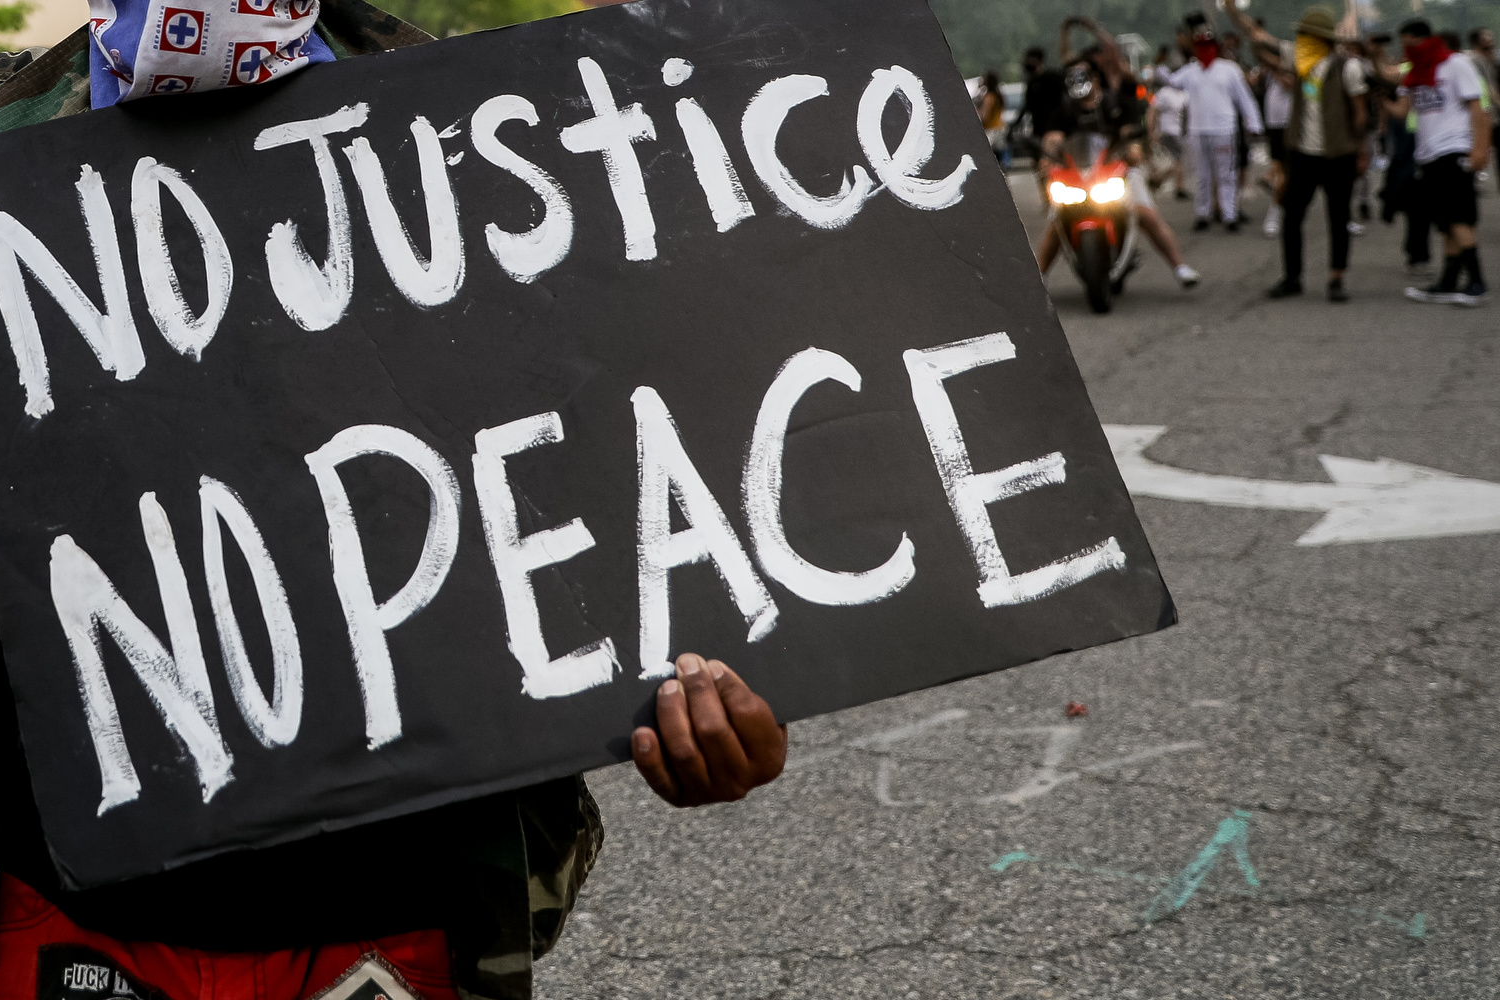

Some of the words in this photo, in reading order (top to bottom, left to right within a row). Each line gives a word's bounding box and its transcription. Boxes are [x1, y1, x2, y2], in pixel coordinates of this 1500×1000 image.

[153, 5, 165, 50] DEPORTIVO
[200, 35, 209, 56] CRUZ
[50, 474, 304, 817] NO
[304, 332, 1127, 753] PEACE
[63, 962, 110, 991] FUCK
